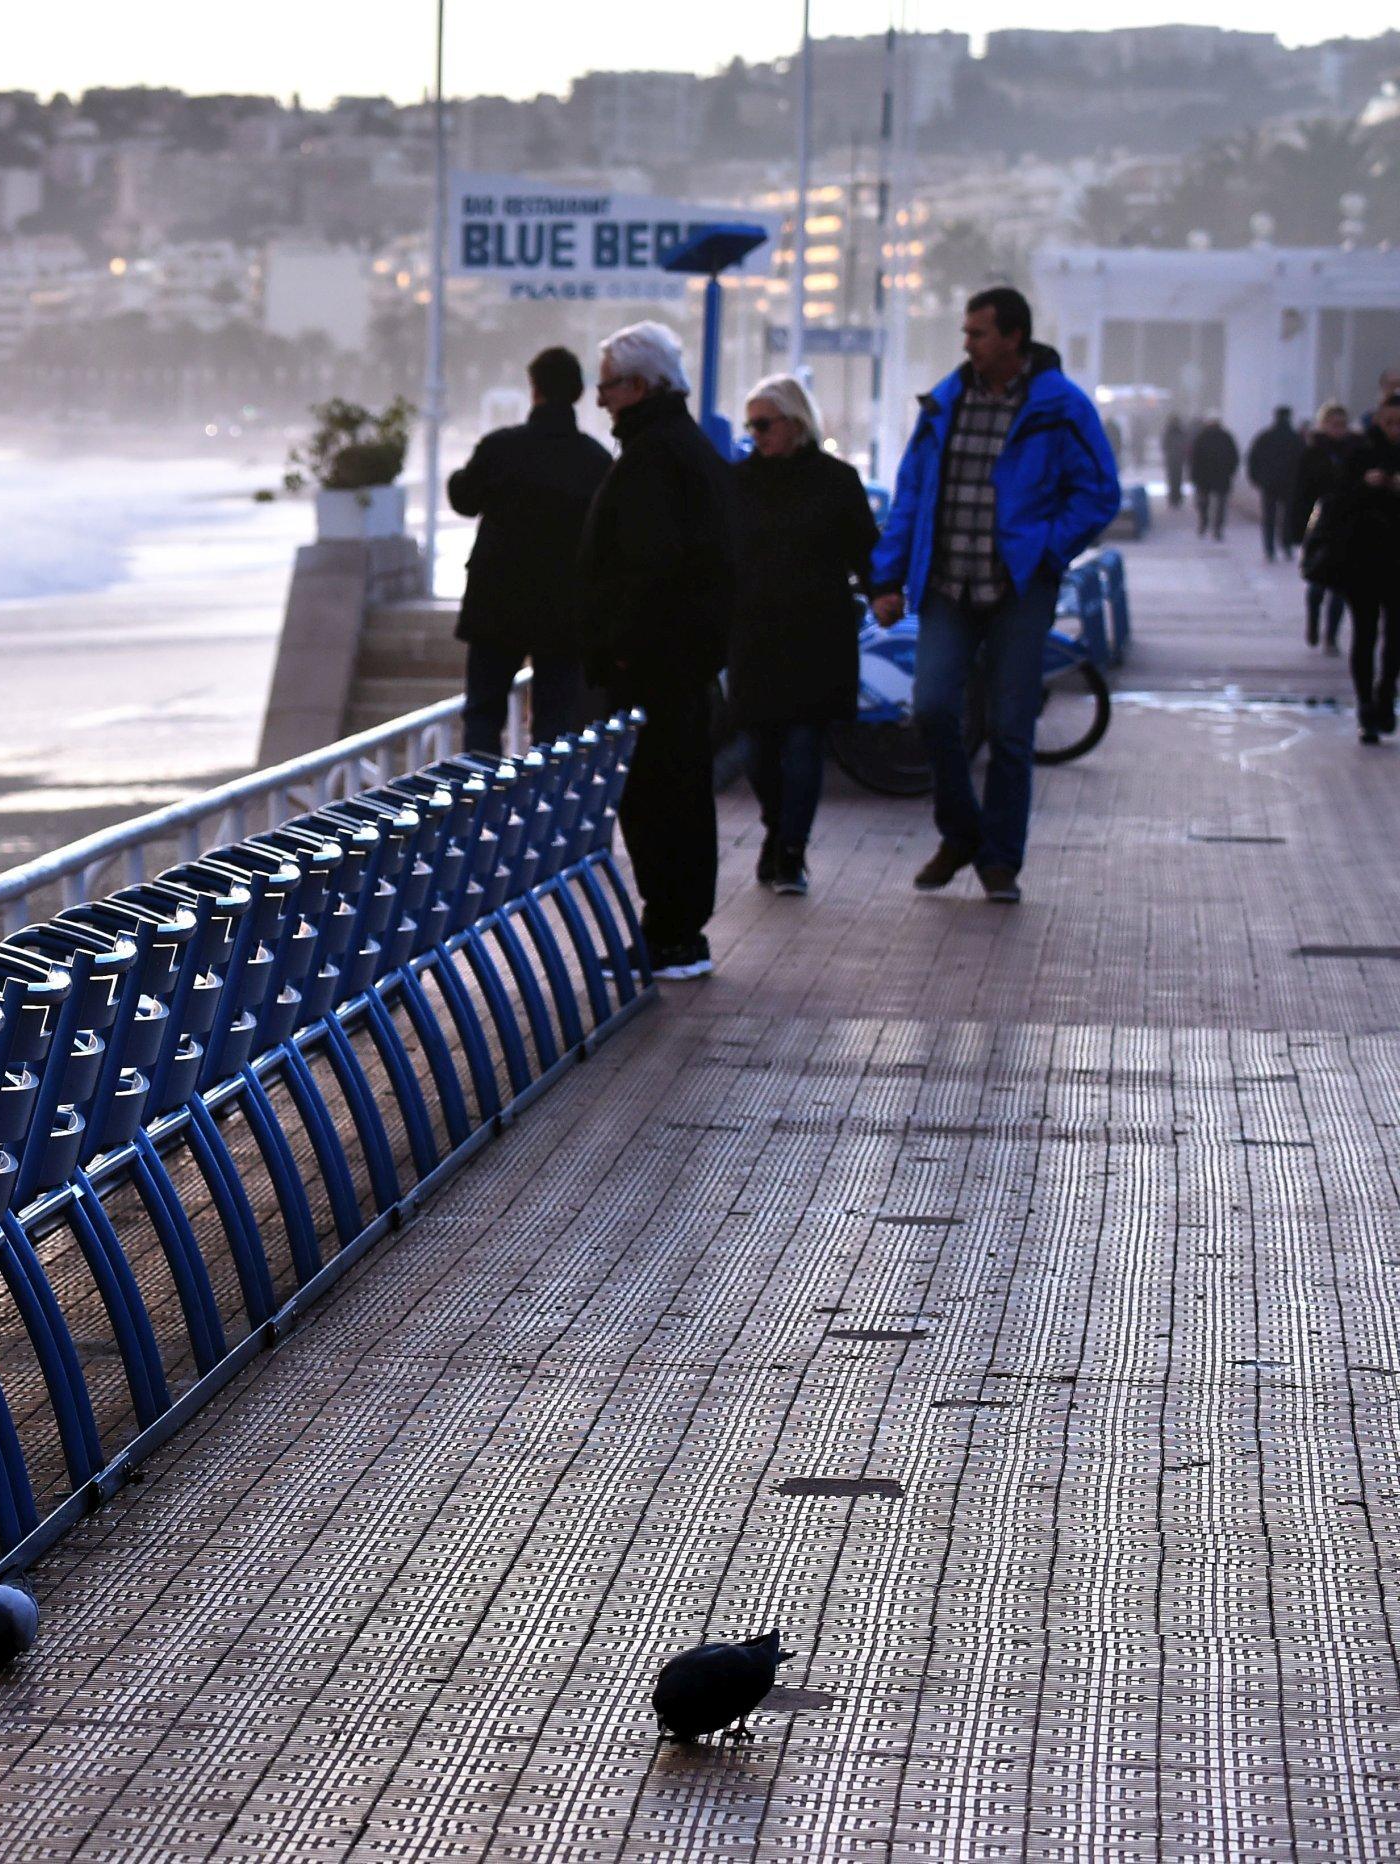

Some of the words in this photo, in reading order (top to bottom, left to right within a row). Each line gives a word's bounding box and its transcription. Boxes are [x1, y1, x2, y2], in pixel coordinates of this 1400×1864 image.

[503, 195, 610, 216] RESTAURANT
[461, 222, 577, 269] BLUE
[510, 281, 596, 299] PLAGE
